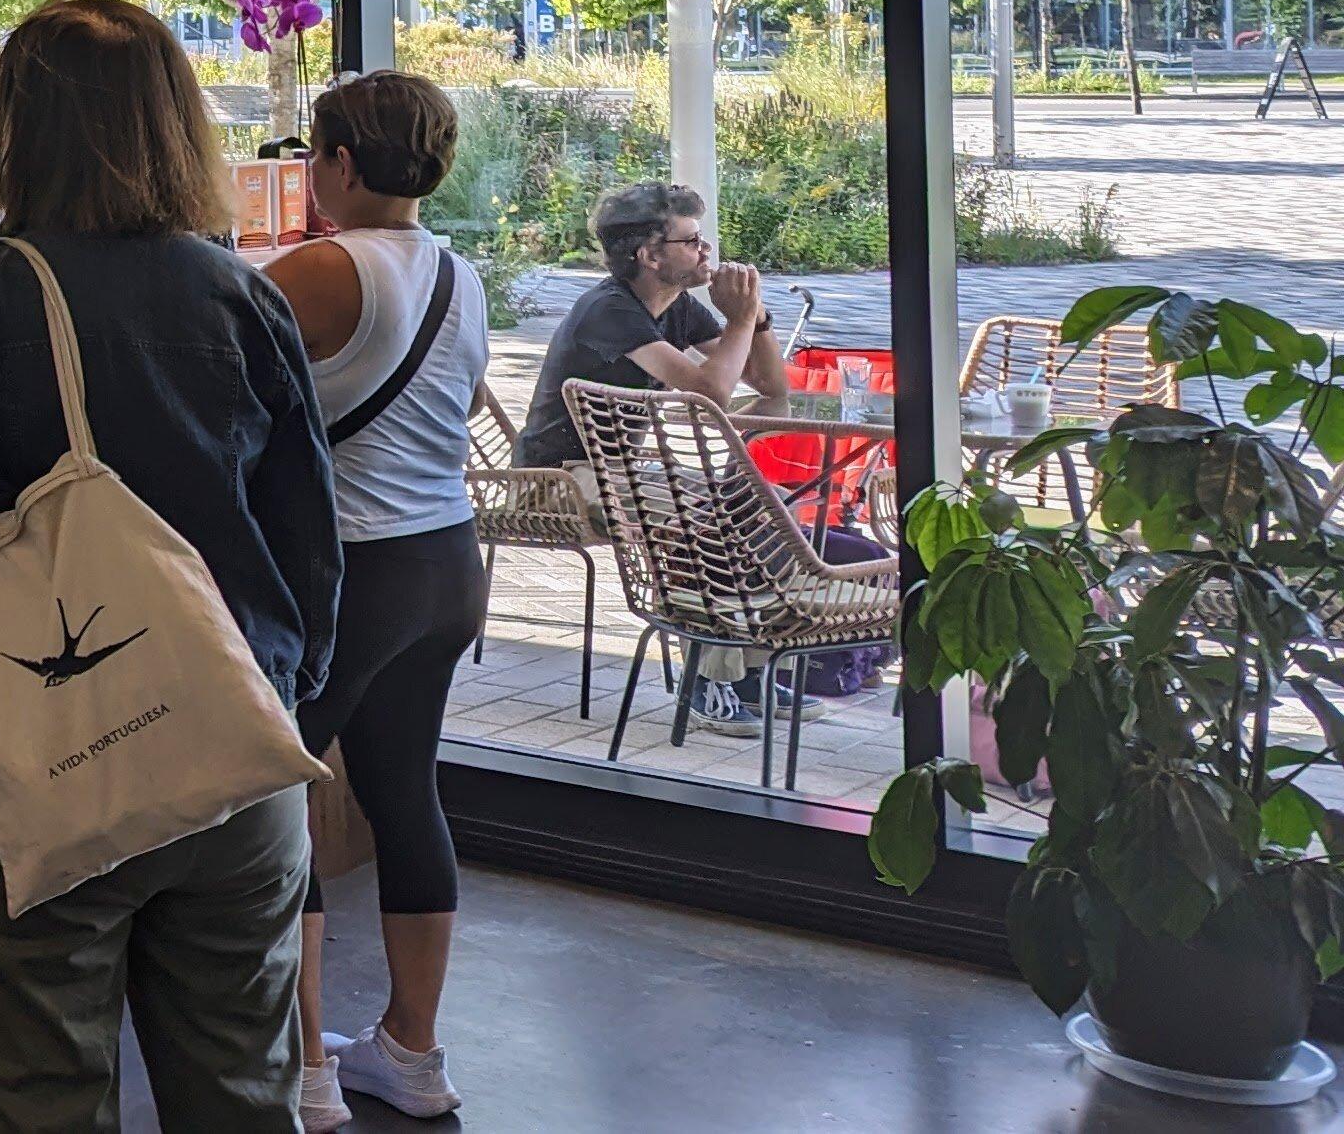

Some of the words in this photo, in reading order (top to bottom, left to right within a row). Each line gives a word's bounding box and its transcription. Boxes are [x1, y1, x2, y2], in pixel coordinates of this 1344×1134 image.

[48, 767, 60, 780] A
[57, 750, 89, 772] VIDA
[88, 703, 171, 756] PORTUGUESA
